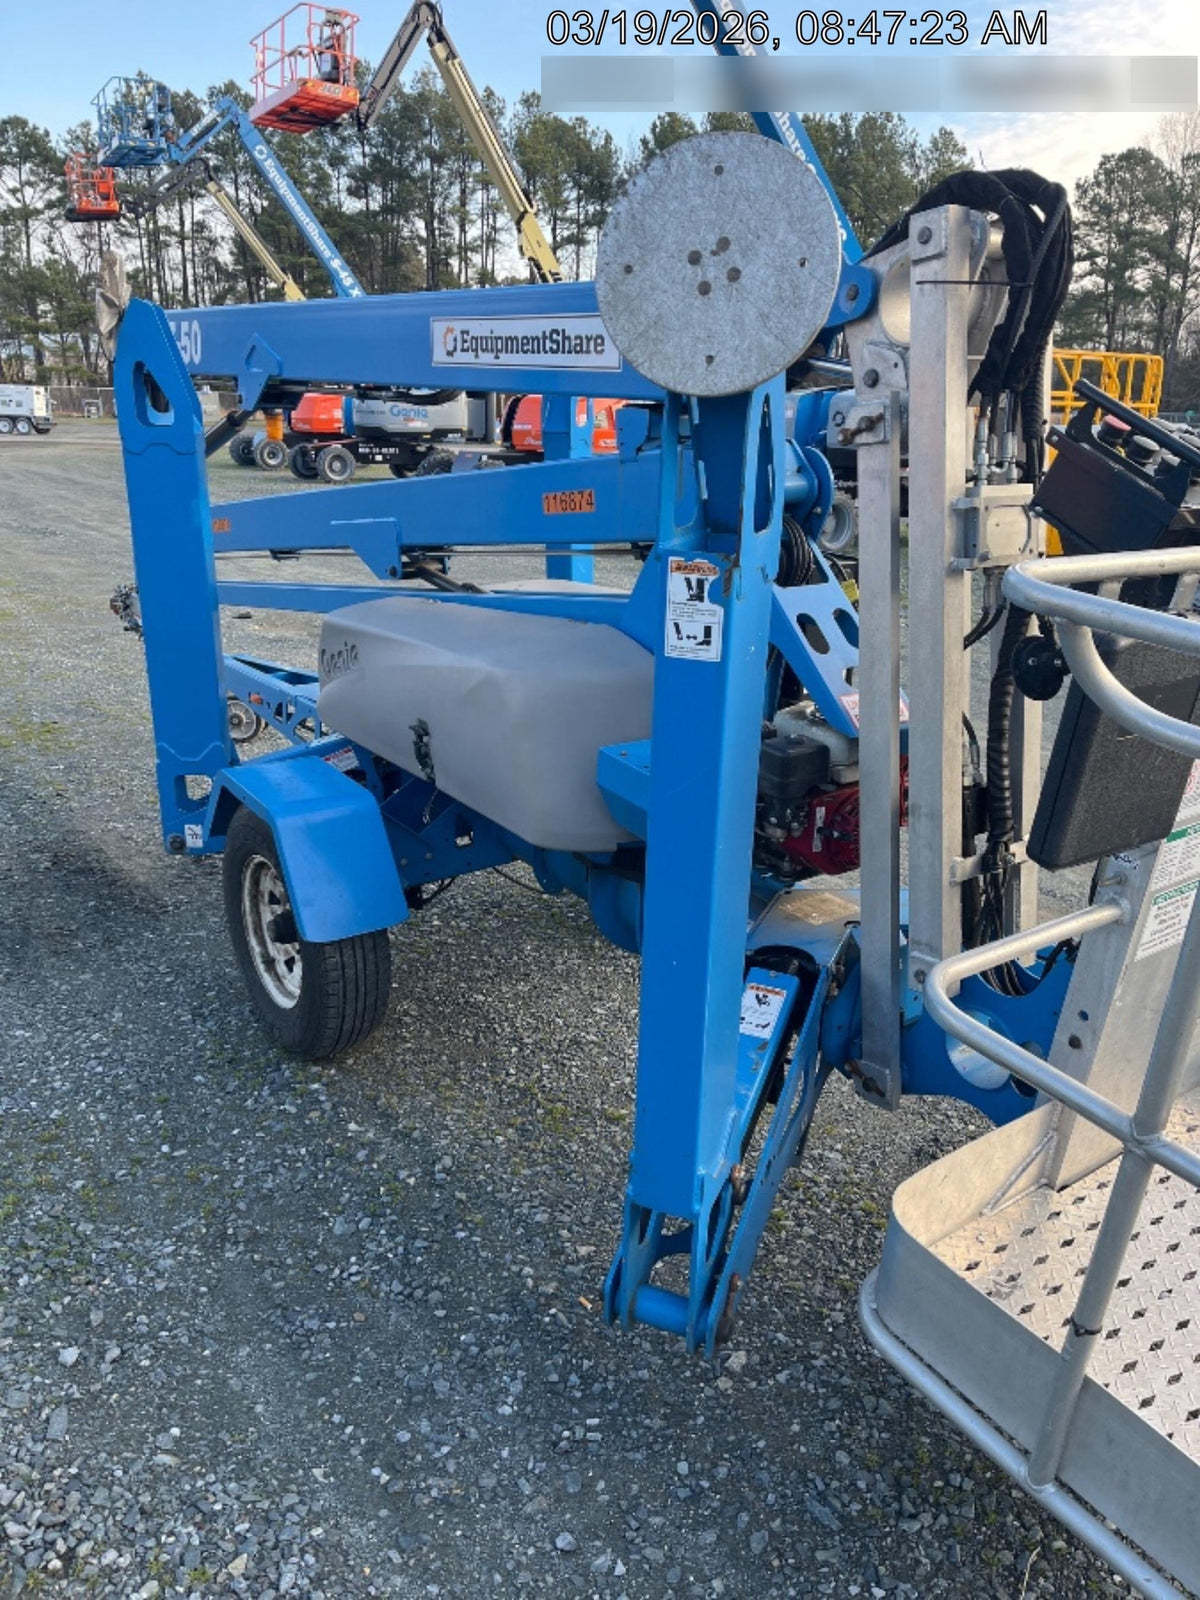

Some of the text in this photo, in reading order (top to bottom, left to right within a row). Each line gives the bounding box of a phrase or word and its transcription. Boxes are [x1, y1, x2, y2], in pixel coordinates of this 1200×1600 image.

[460, 329, 605, 359] EquipmentShare
[390, 405, 428, 419] Genie
[544, 490, 594, 512] 116874
